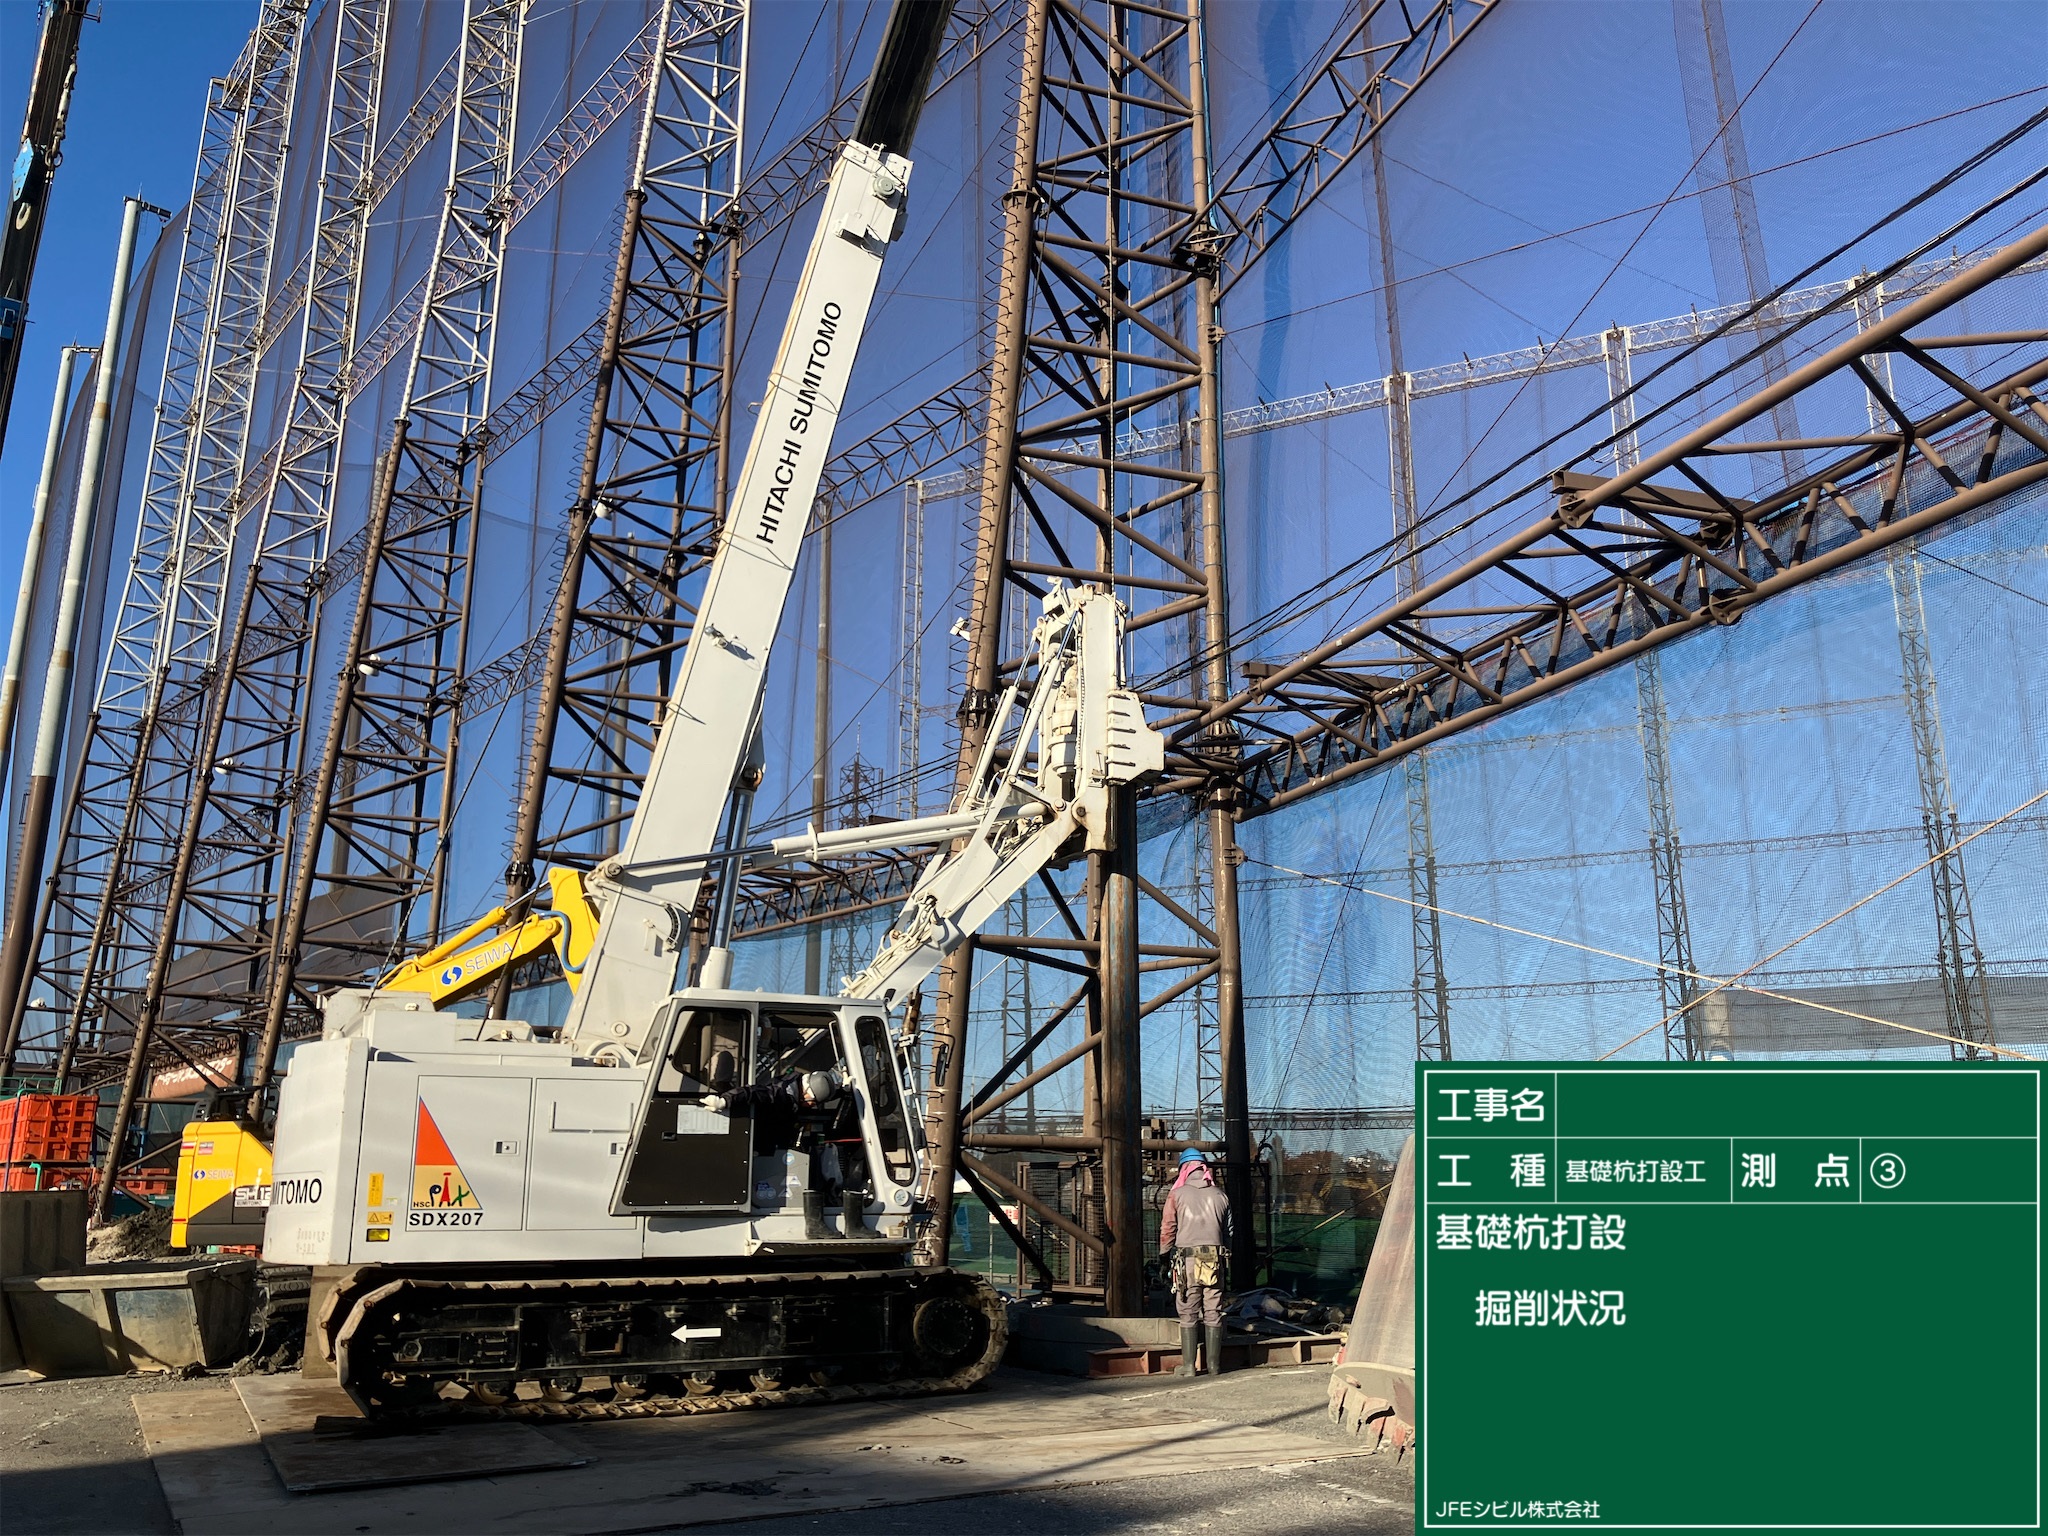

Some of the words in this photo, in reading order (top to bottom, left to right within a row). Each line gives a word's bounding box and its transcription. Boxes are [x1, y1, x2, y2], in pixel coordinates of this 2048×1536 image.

[756, 439, 802, 544] HITACHI
[790, 301, 842, 434] SUMITOMO
[465, 942, 513, 974] SEIWA
[409, 1212, 483, 1226] SDX207
